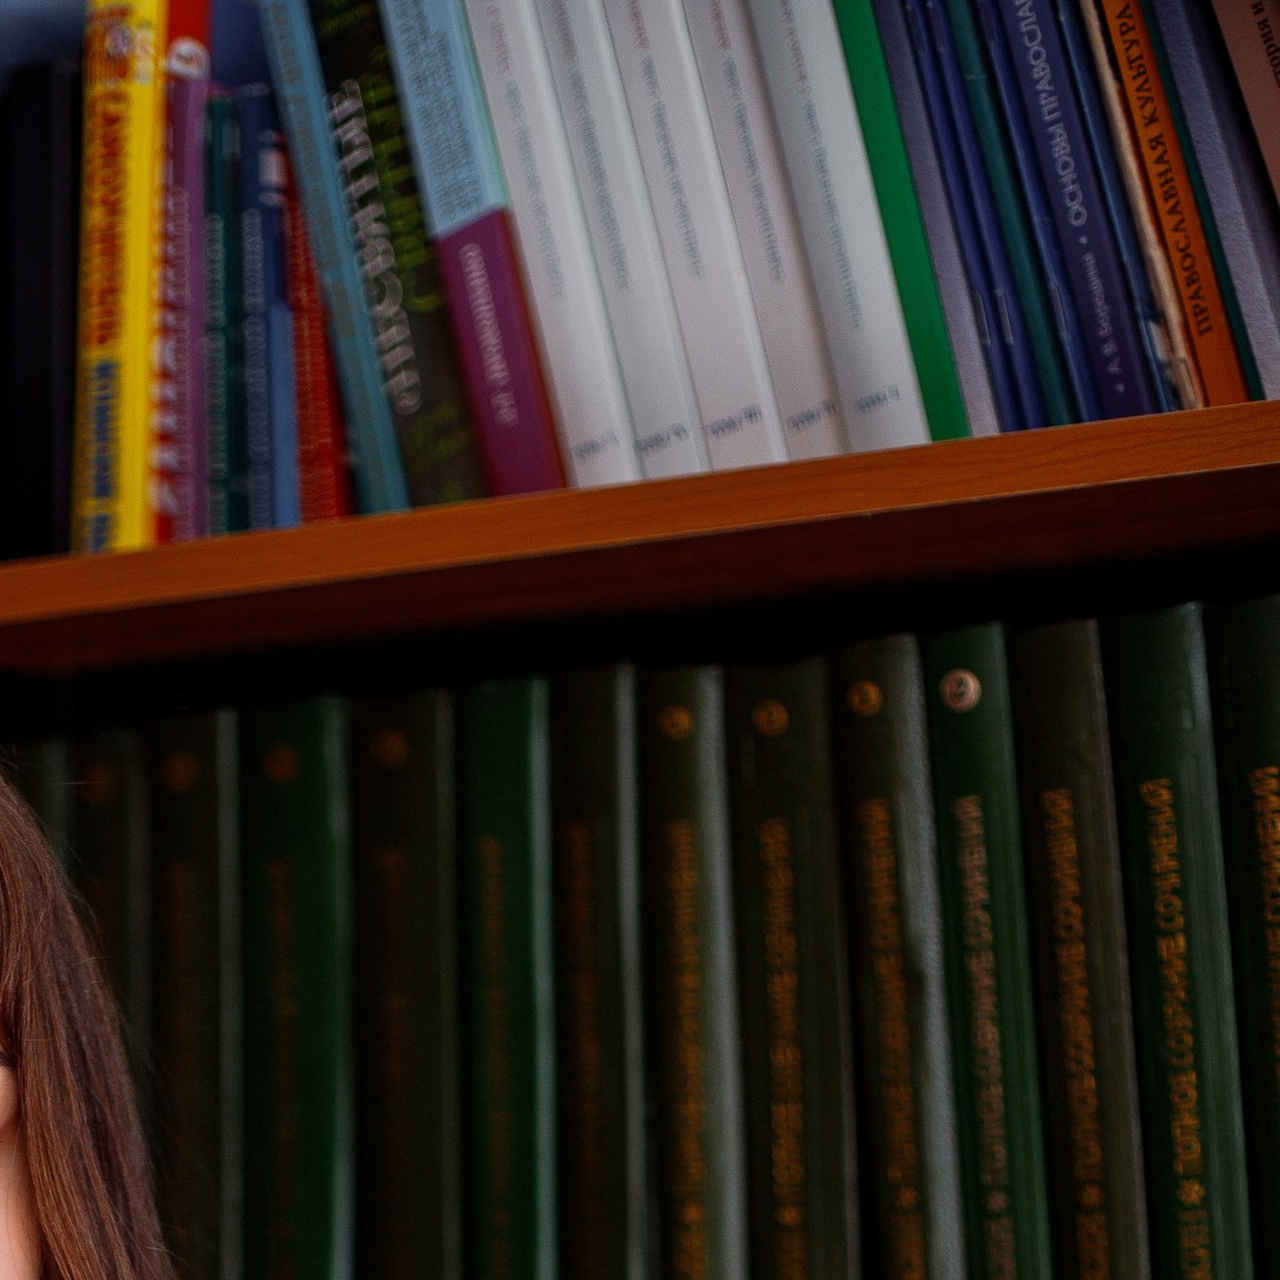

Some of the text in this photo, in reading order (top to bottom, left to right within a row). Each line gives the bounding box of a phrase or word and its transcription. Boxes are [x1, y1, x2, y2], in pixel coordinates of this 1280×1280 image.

[1047, 122, 1088, 228] ОСНОВЫ
[1115, 9, 1213, 337] ПРАВОСЛАВНАЯ КУЛЬТУРА
[1139, 778, 1186, 930] СОЧИНЕНИЙ
[1159, 932, 1195, 1068] СОБРАНИЕ
[1169, 1069, 1205, 1177] ПОЛНОЕ
